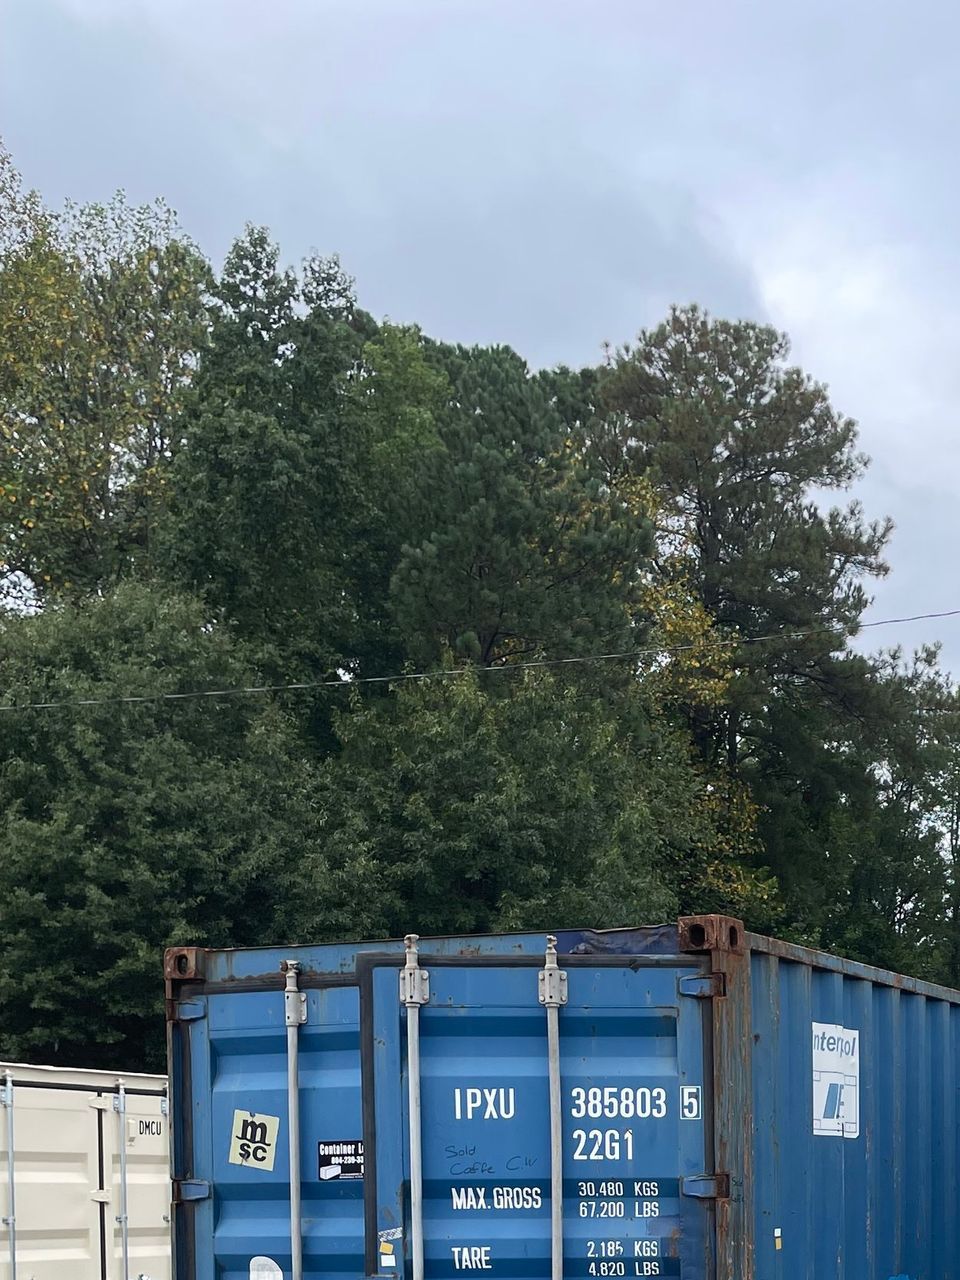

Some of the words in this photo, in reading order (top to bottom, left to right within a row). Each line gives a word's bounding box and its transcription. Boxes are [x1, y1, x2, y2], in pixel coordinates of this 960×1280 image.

[455, 1088, 515, 1119] IPXU
[571, 1087, 667, 1118] 385803
[683, 1088, 698, 1118] 5
[139, 1121, 161, 1136] DMCU
[320, 1143, 355, 1155] Container
[445, 1144, 476, 1159] Sold
[573, 1129, 633, 1160] 22G1
[451, 1187, 491, 1210] MAX.
[493, 1187, 542, 1209] GROSS
[634, 1181, 659, 1196] KGS
[635, 1201, 660, 1217] LBS
[451, 1247, 492, 1269] TARE
[634, 1240, 658, 1257] KGS
[635, 1262, 660, 1276] LBS
